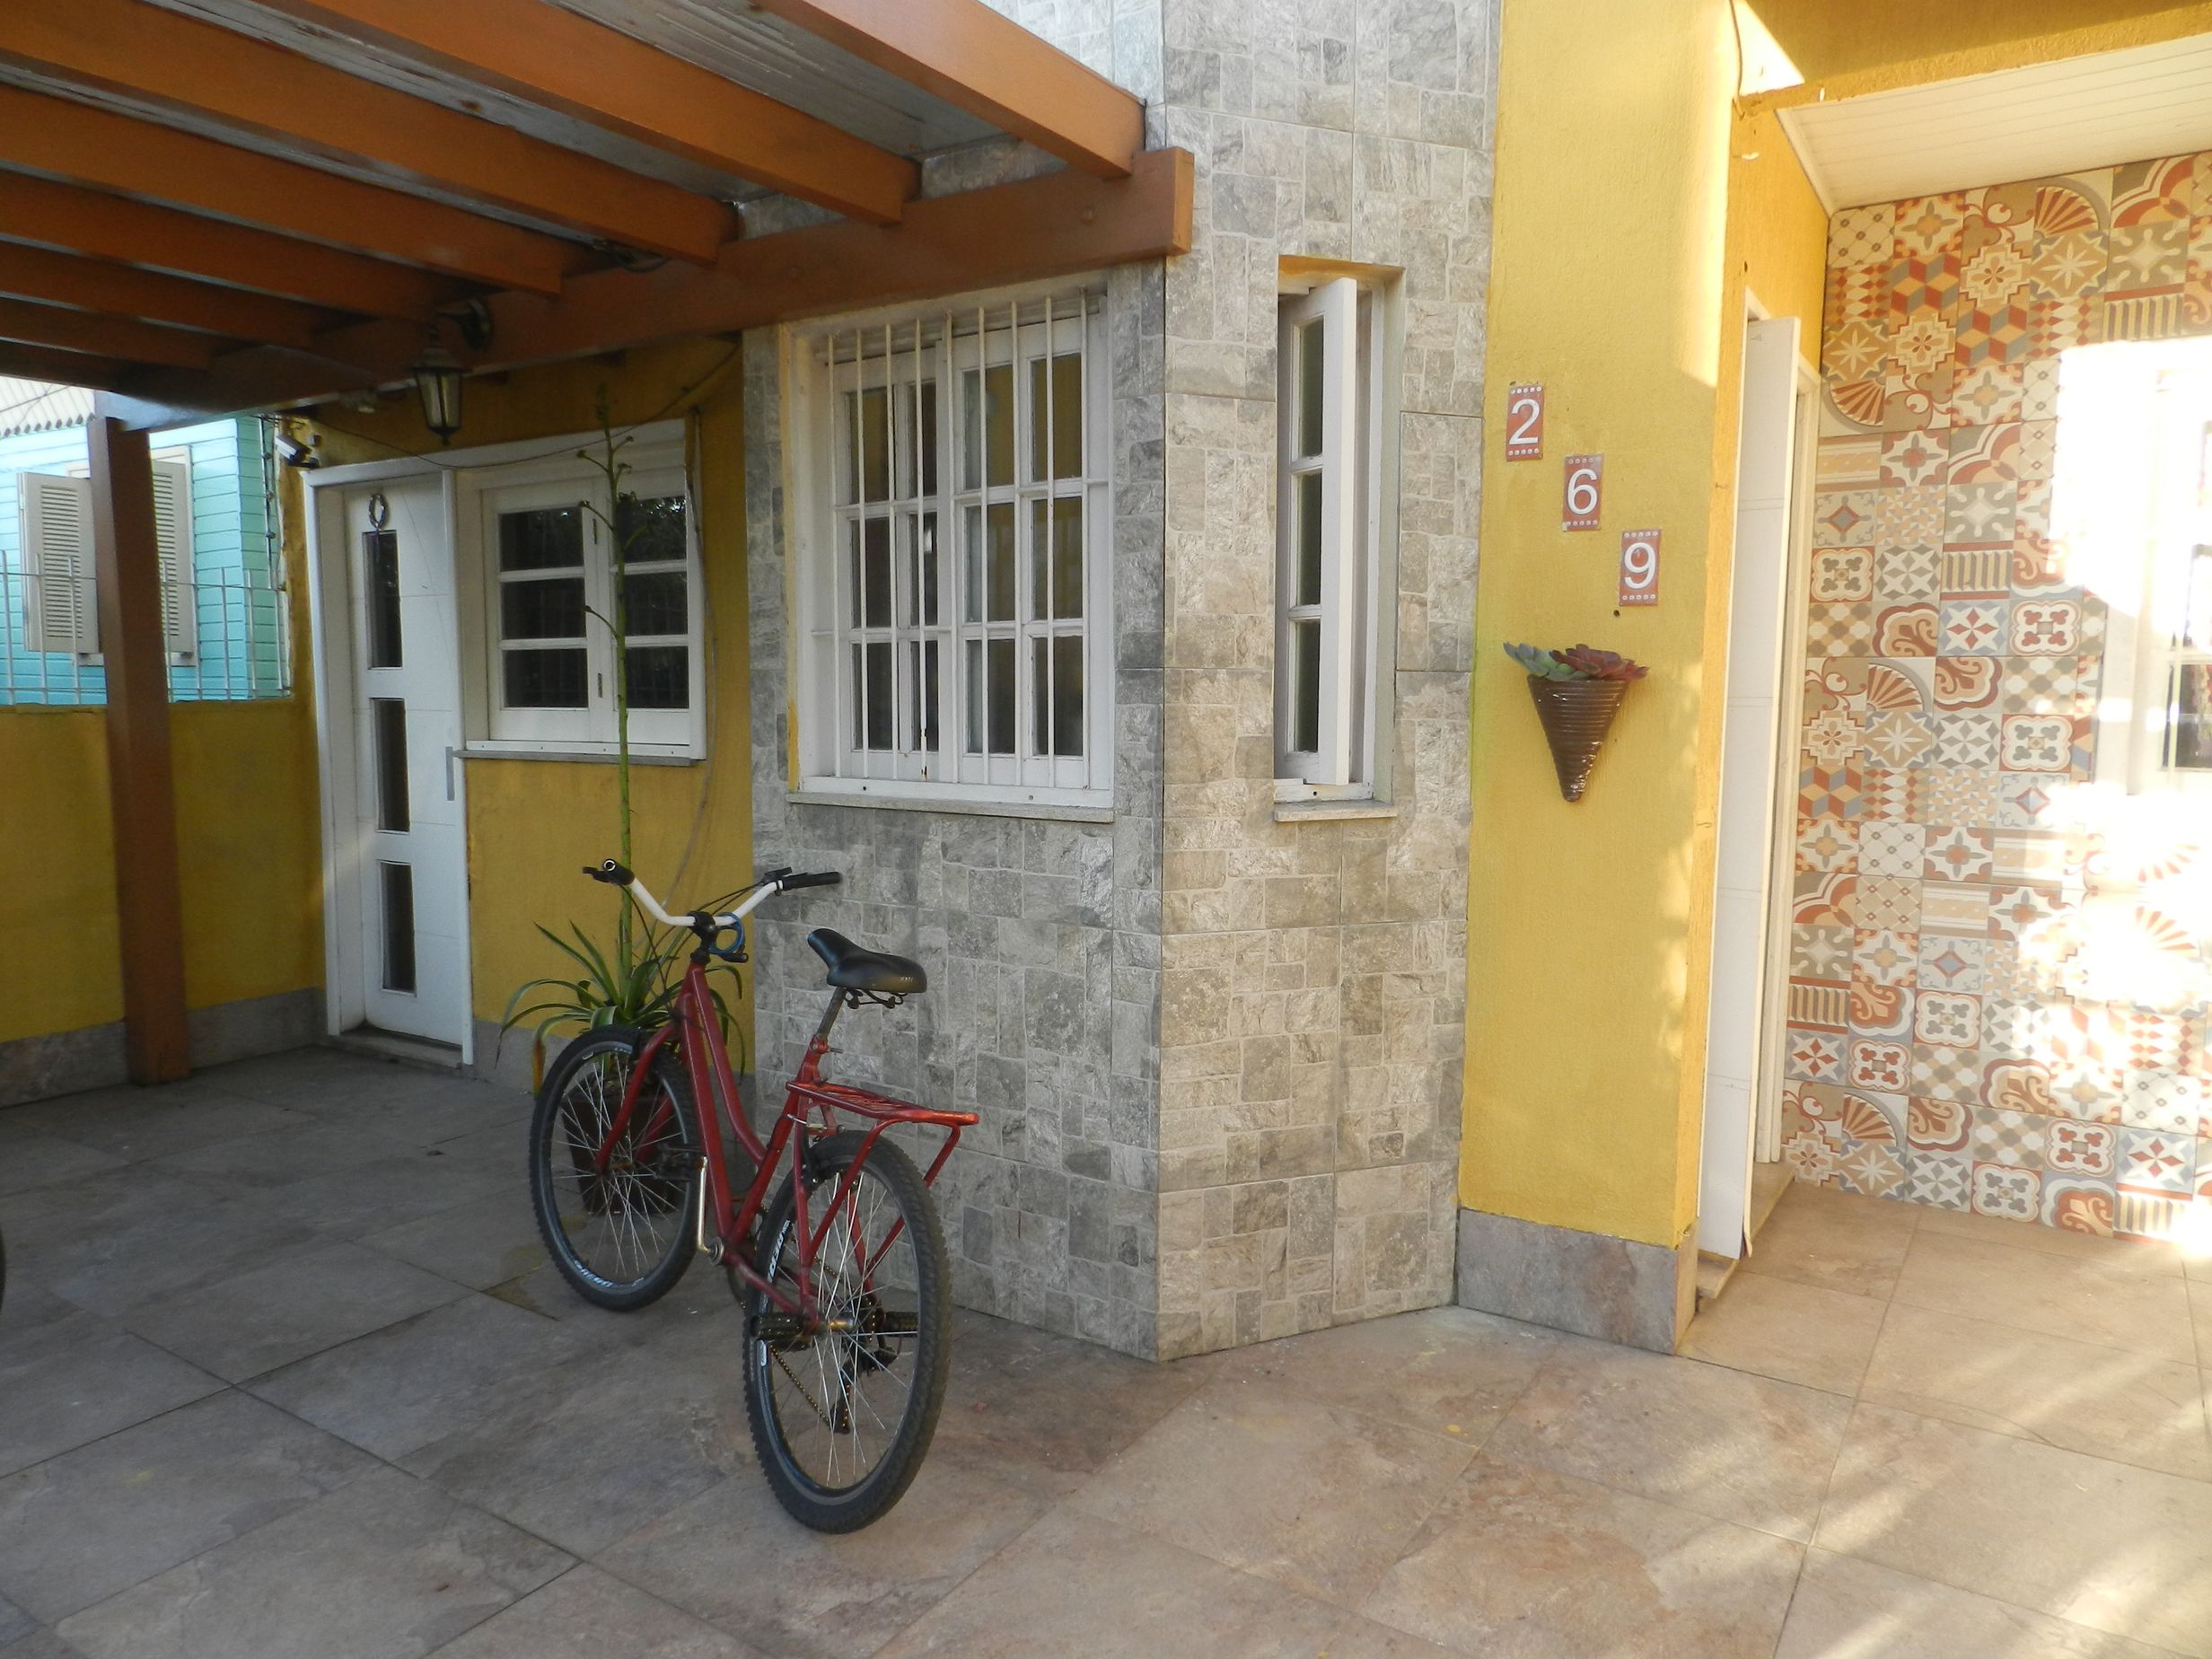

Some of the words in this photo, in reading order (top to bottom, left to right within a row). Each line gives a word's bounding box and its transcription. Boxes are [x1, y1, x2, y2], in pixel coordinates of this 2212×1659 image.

[1508, 399, 1540, 445] 2
[1567, 468, 1598, 515] 6
[1623, 541, 1656, 589] 9
